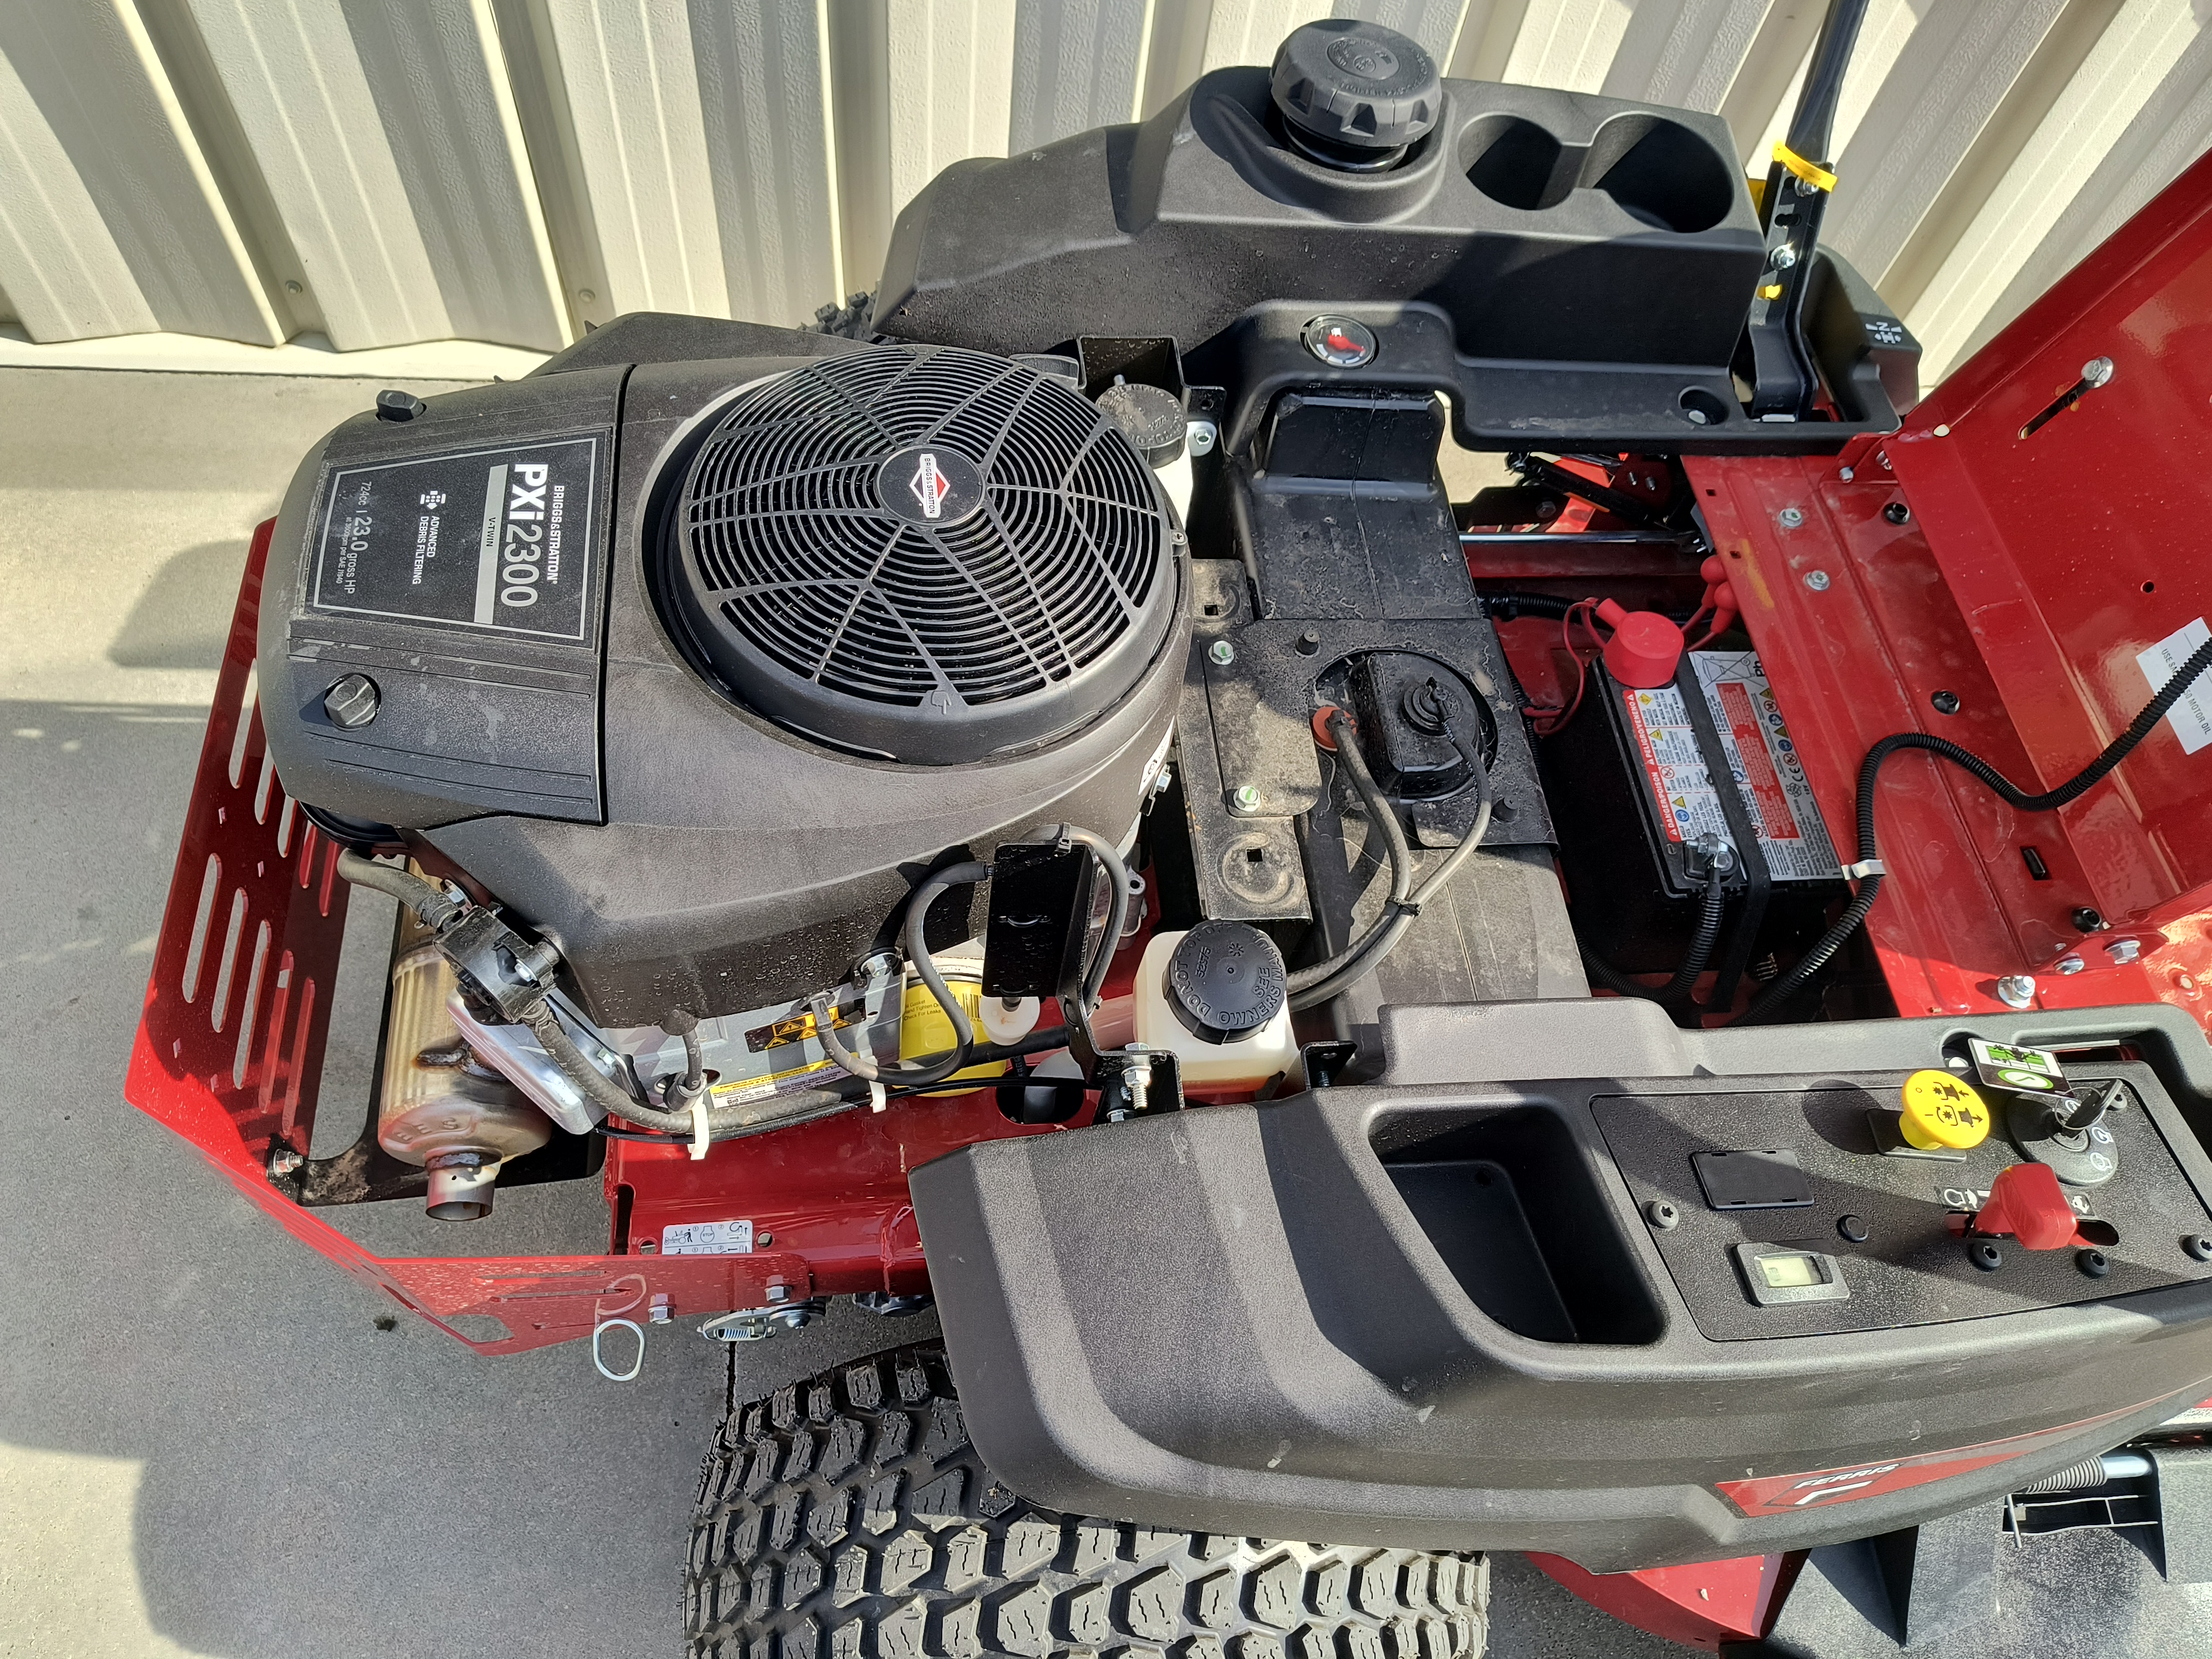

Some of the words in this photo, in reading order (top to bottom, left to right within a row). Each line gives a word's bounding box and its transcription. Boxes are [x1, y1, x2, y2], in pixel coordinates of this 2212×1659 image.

[358, 482, 372, 505] 724cc
[350, 517, 372, 551] 23.0
[417, 516, 429, 543] DEBRIS
[427, 516, 440, 557] ADVANCED
[486, 517, 496, 547] V-TWIN
[338, 557, 347, 568] SAE
[346, 552, 358, 577] gross
[413, 545, 425, 584] FILTERING
[344, 579, 356, 594] HP
[2161, 649, 2172, 663] USE
[2188, 698, 2206, 723] MOTOR
[2201, 723, 2211, 735] OIL
[1177, 932, 1201, 956] TOP
[1175, 960, 1193, 995] NOT
[1253, 968, 1269, 997] SEE
[904, 1013, 916, 1021] Check
[910, 1000, 926, 1008] Gasket
[1188, 994, 1211, 1016] DO
[1218, 986, 1281, 1024] OWNERS
[1793, 1464, 1899, 1489] FERRIS
